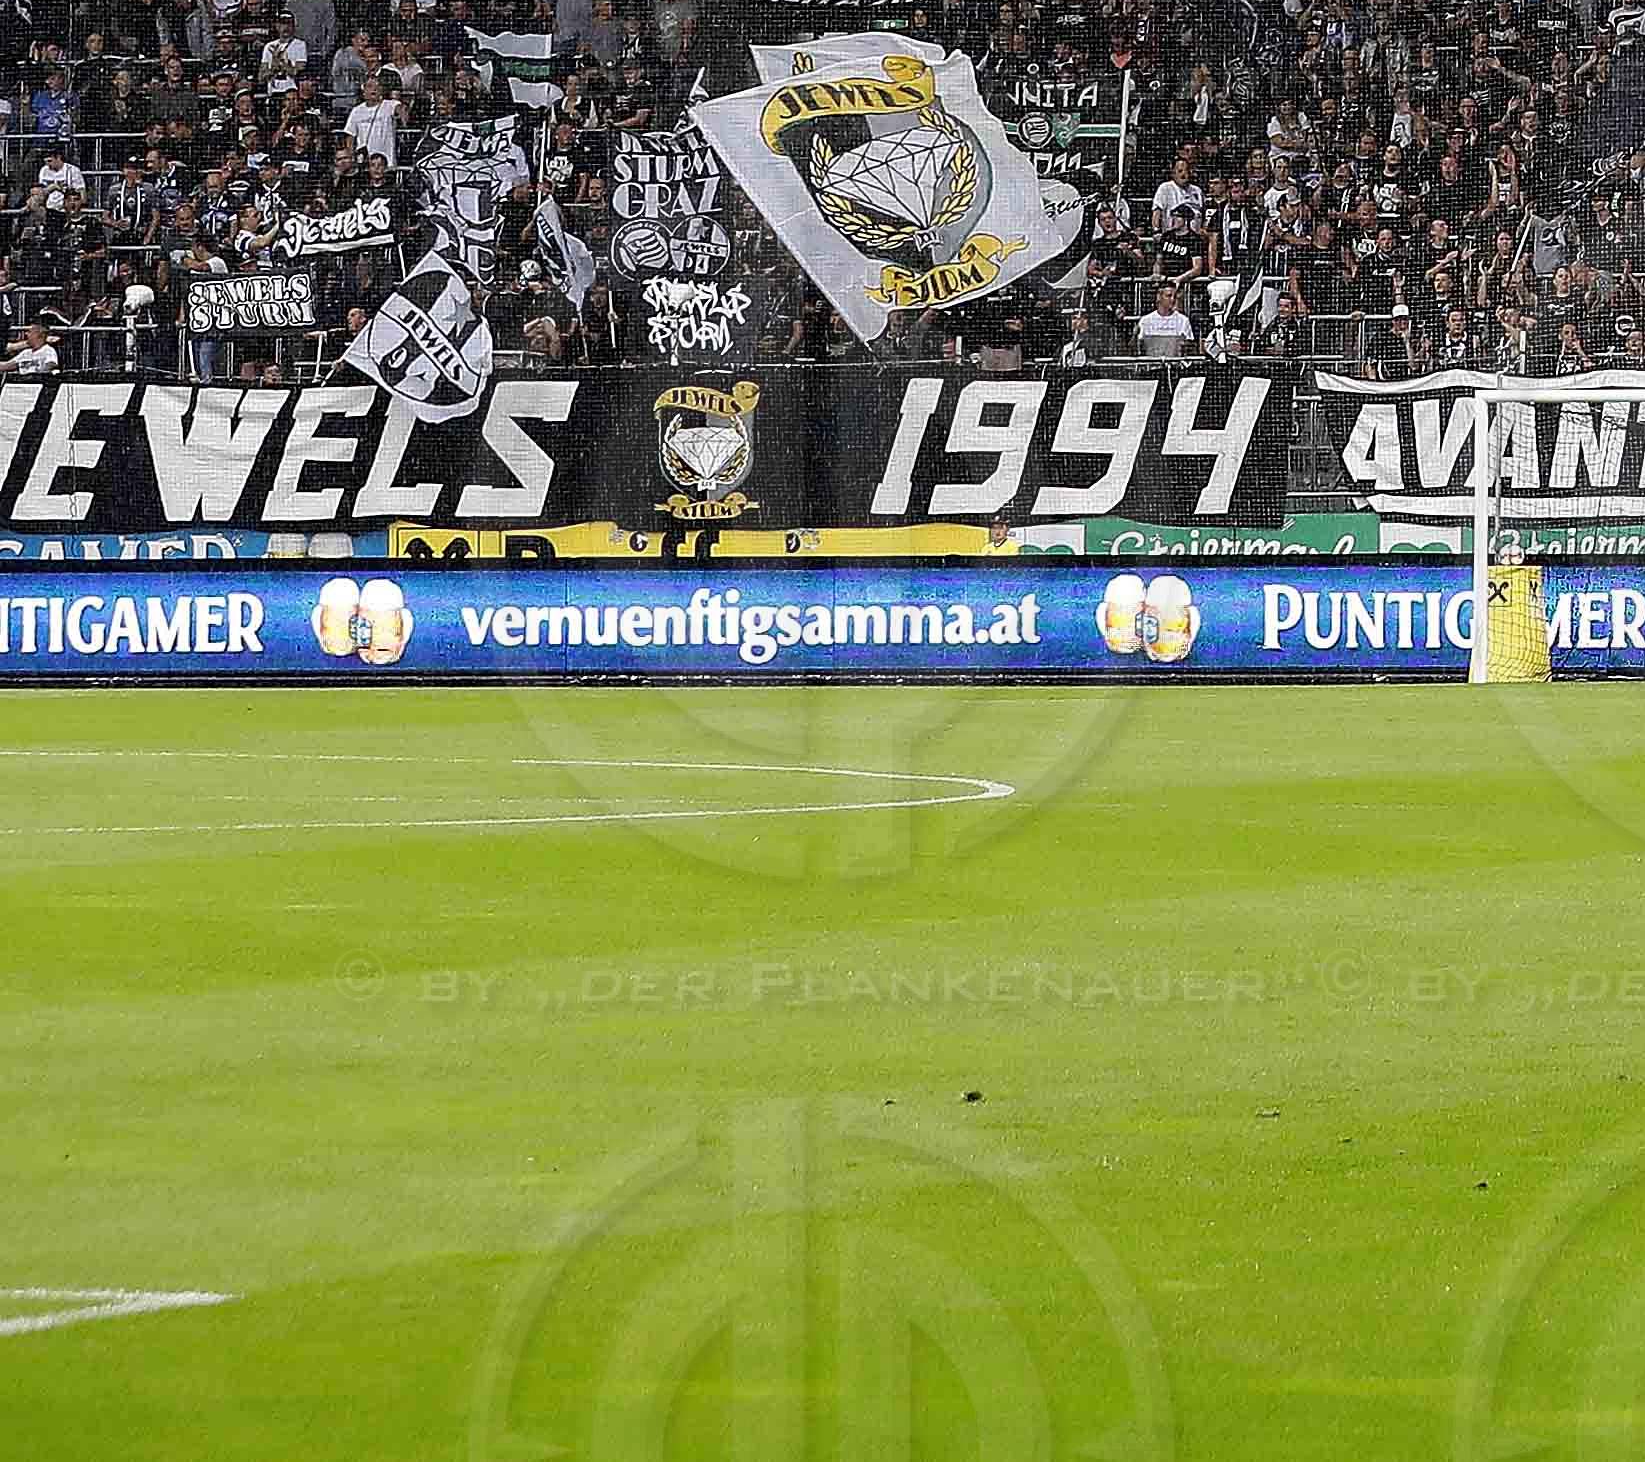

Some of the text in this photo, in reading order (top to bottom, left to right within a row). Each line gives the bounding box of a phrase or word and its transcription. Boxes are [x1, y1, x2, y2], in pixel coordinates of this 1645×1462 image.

[776, 79, 927, 122] JEWELS
[613, 147, 721, 183] STURM
[612, 175, 723, 219] GRAZ
[190, 274, 312, 307] JEWELS
[188, 298, 318, 332] STURM
[397, 307, 467, 383] JEWELS
[671, 388, 742, 414] JEWELS
[868, 377, 1272, 520] 1994
[462, 587, 1041, 663] vernuenftigsamma.at
